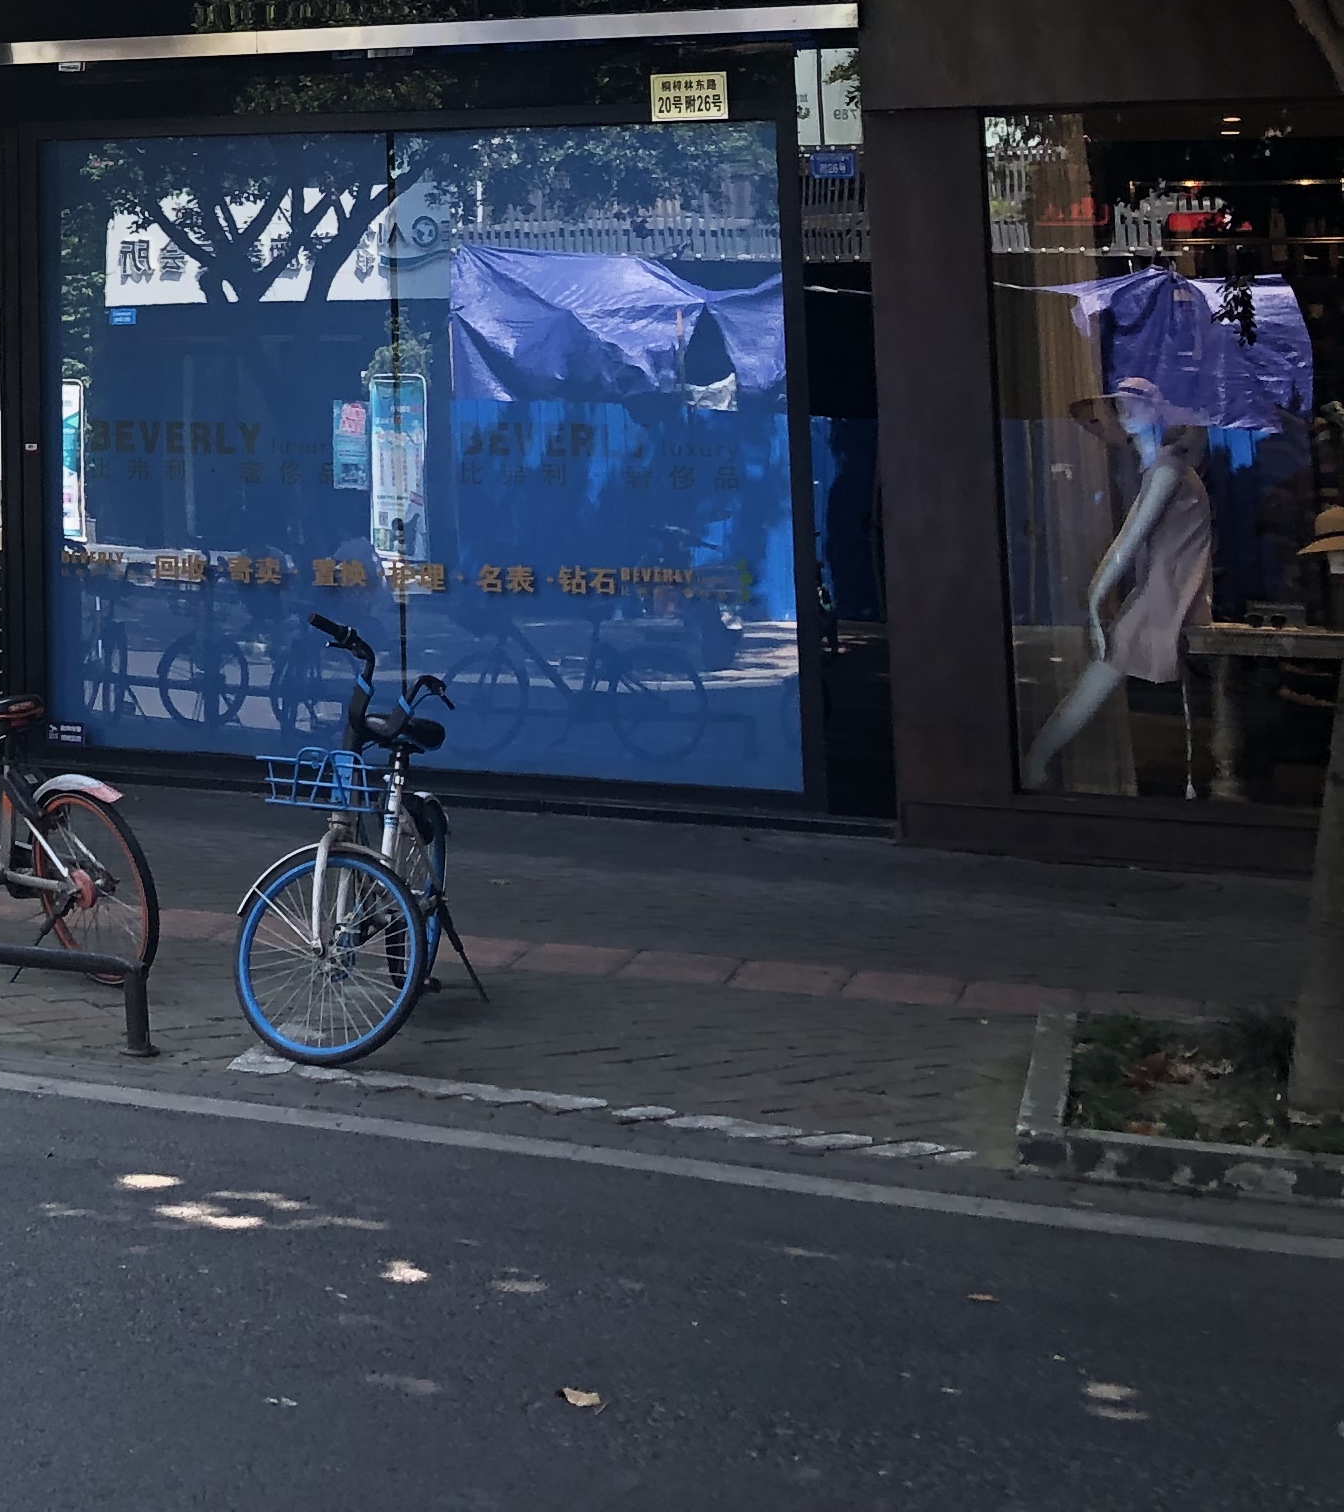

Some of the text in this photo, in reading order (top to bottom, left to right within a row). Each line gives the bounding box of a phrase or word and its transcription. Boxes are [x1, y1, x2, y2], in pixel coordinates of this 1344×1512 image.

[661, 78, 717, 92] 桐梓林东路
[658, 94, 723, 114] 20号附26号
[91, 420, 330, 455] BEVERLY luxur
[461, 422, 651, 458] BEVER
[459, 460, 740, 490] 比弗利奢侈品
[155, 554, 207, 581] 回收
[478, 563, 535, 594] 名表
[558, 565, 617, 594] 钻石
